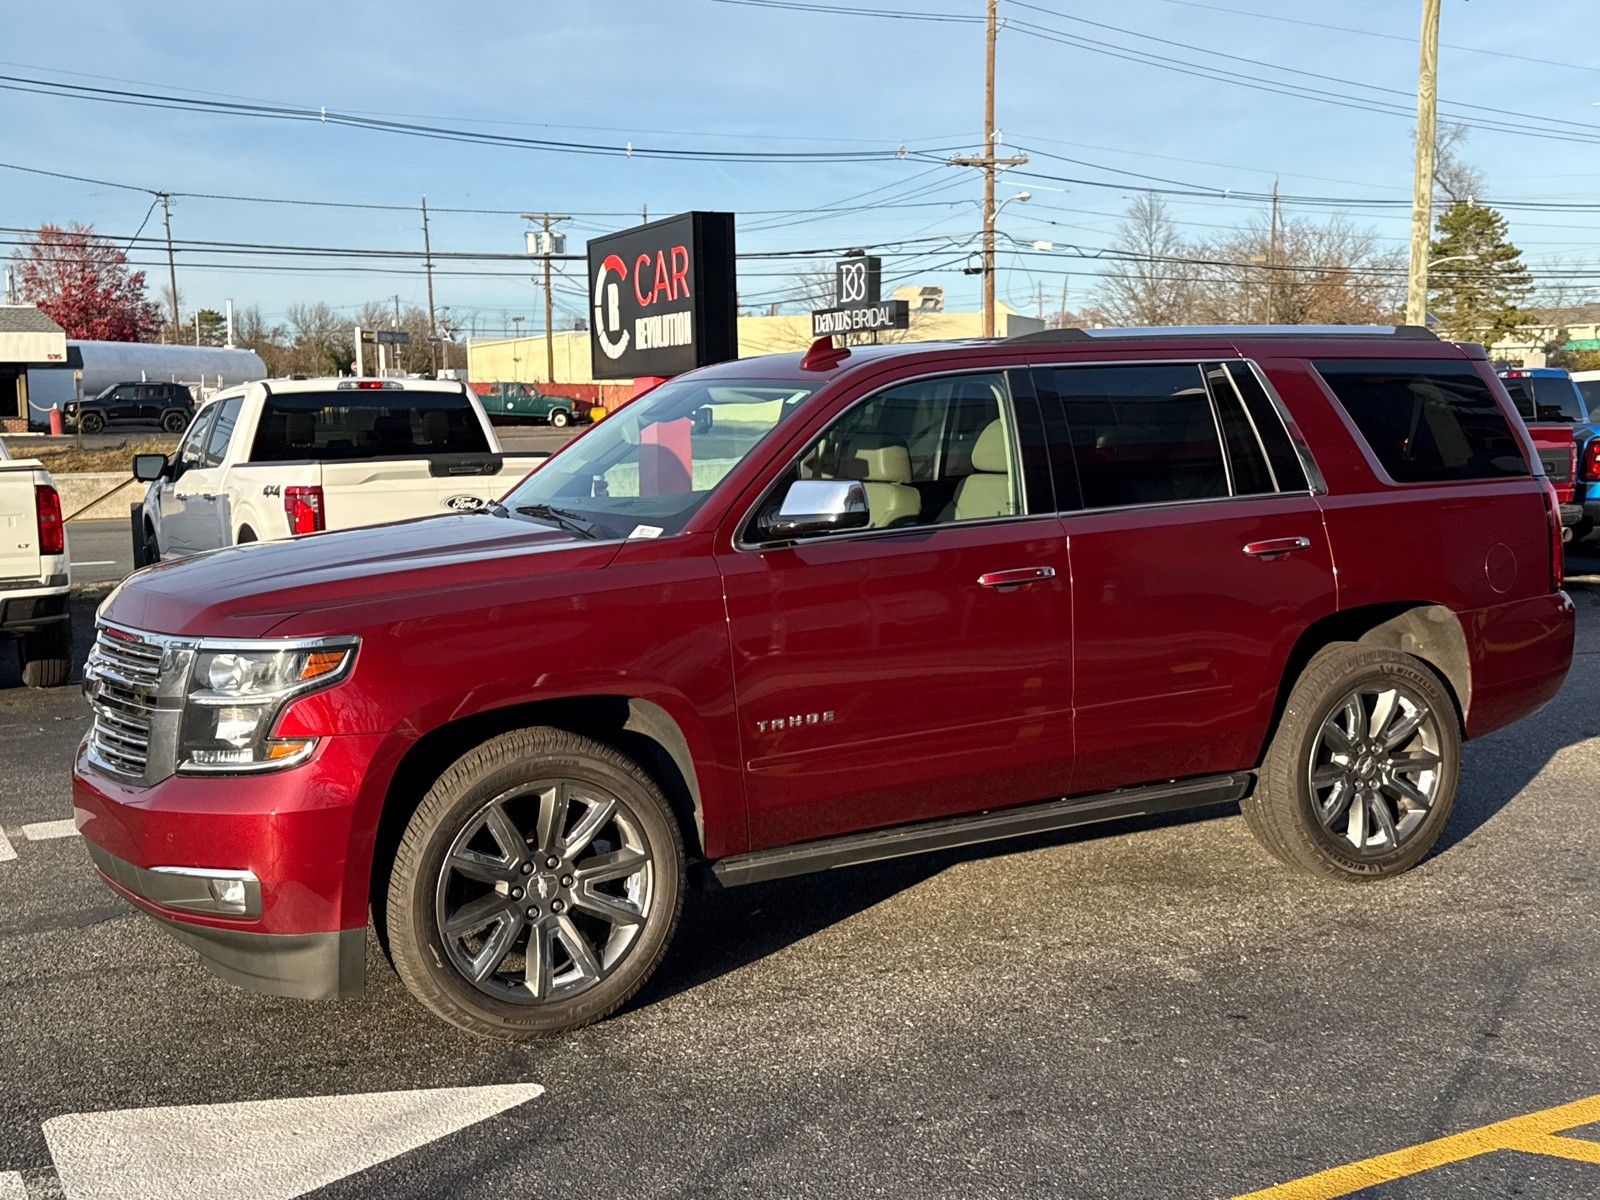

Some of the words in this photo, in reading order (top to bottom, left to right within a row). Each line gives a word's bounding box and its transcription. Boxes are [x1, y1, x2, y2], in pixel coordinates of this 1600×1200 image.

[634, 246, 690, 306] CAR
[635, 311, 691, 350] REVOLUTION
[853, 306, 894, 329] BRIDAL
[451, 496, 480, 510] Ford
[1396, 666, 1437, 696] MICHELIN
[757, 710, 835, 733] TAHOE
